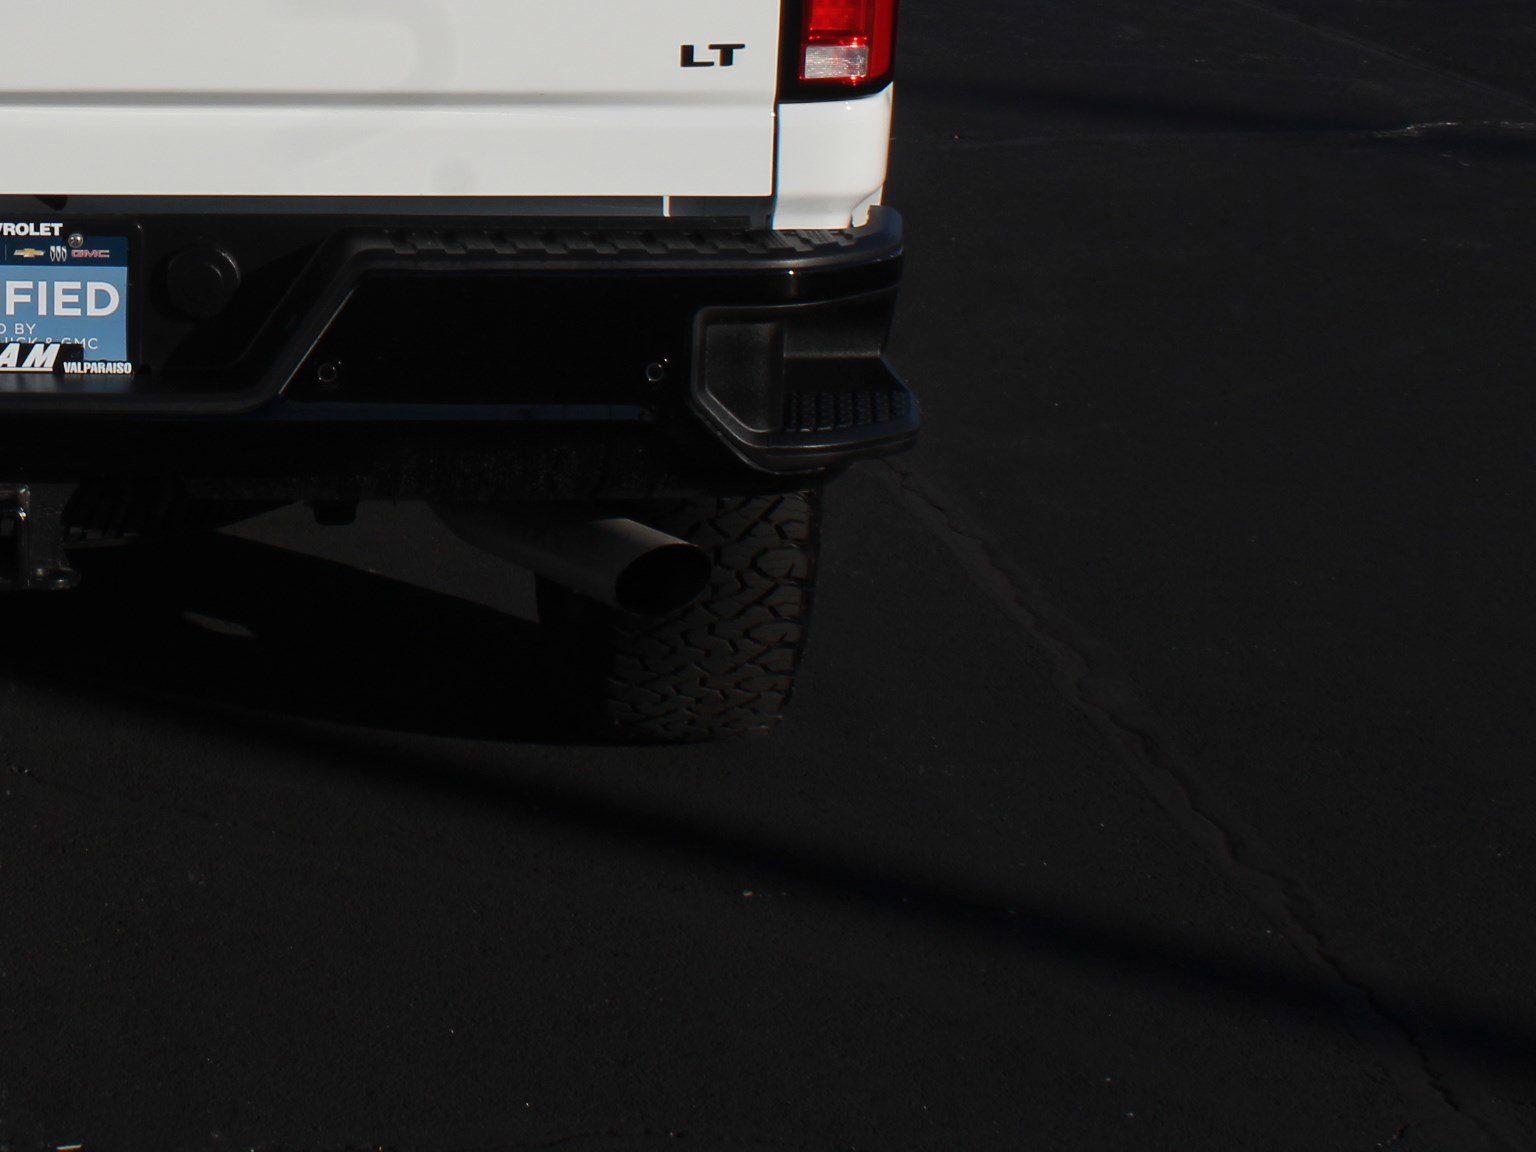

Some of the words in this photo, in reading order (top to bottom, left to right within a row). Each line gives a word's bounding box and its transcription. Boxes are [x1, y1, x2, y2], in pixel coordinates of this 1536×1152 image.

[680, 43, 746, 67] LT
[71, 249, 110, 258] GMC
[15, 322, 37, 335] BY
[63, 361, 132, 374] VALPARAISO
